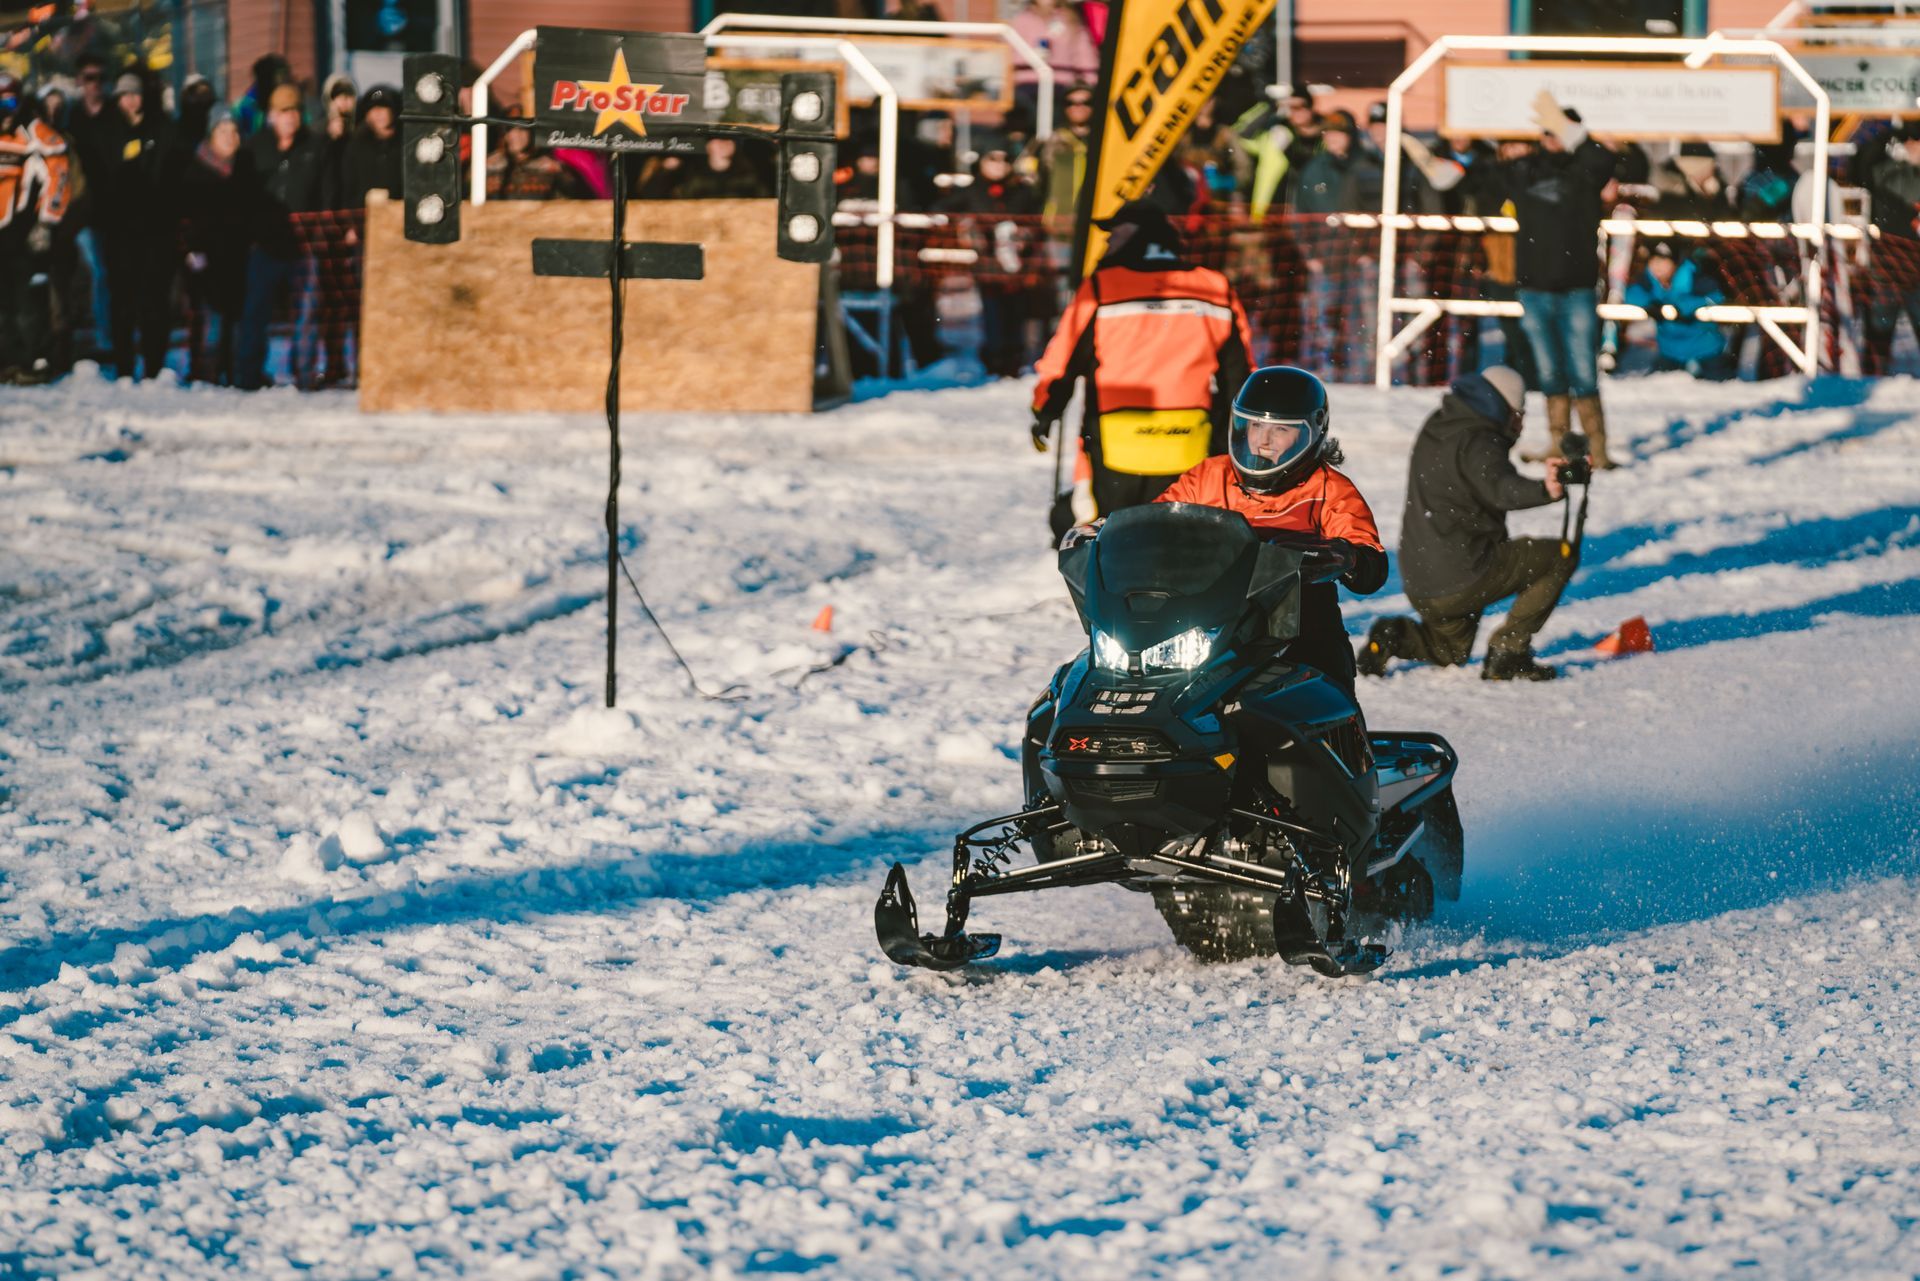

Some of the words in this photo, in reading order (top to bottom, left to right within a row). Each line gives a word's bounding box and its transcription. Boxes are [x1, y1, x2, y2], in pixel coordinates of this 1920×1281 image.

[550, 80, 690, 115] ProStar
[547, 130, 608, 147] Electrical
[610, 134, 664, 150] Services
[667, 137, 695, 150] Inc.
